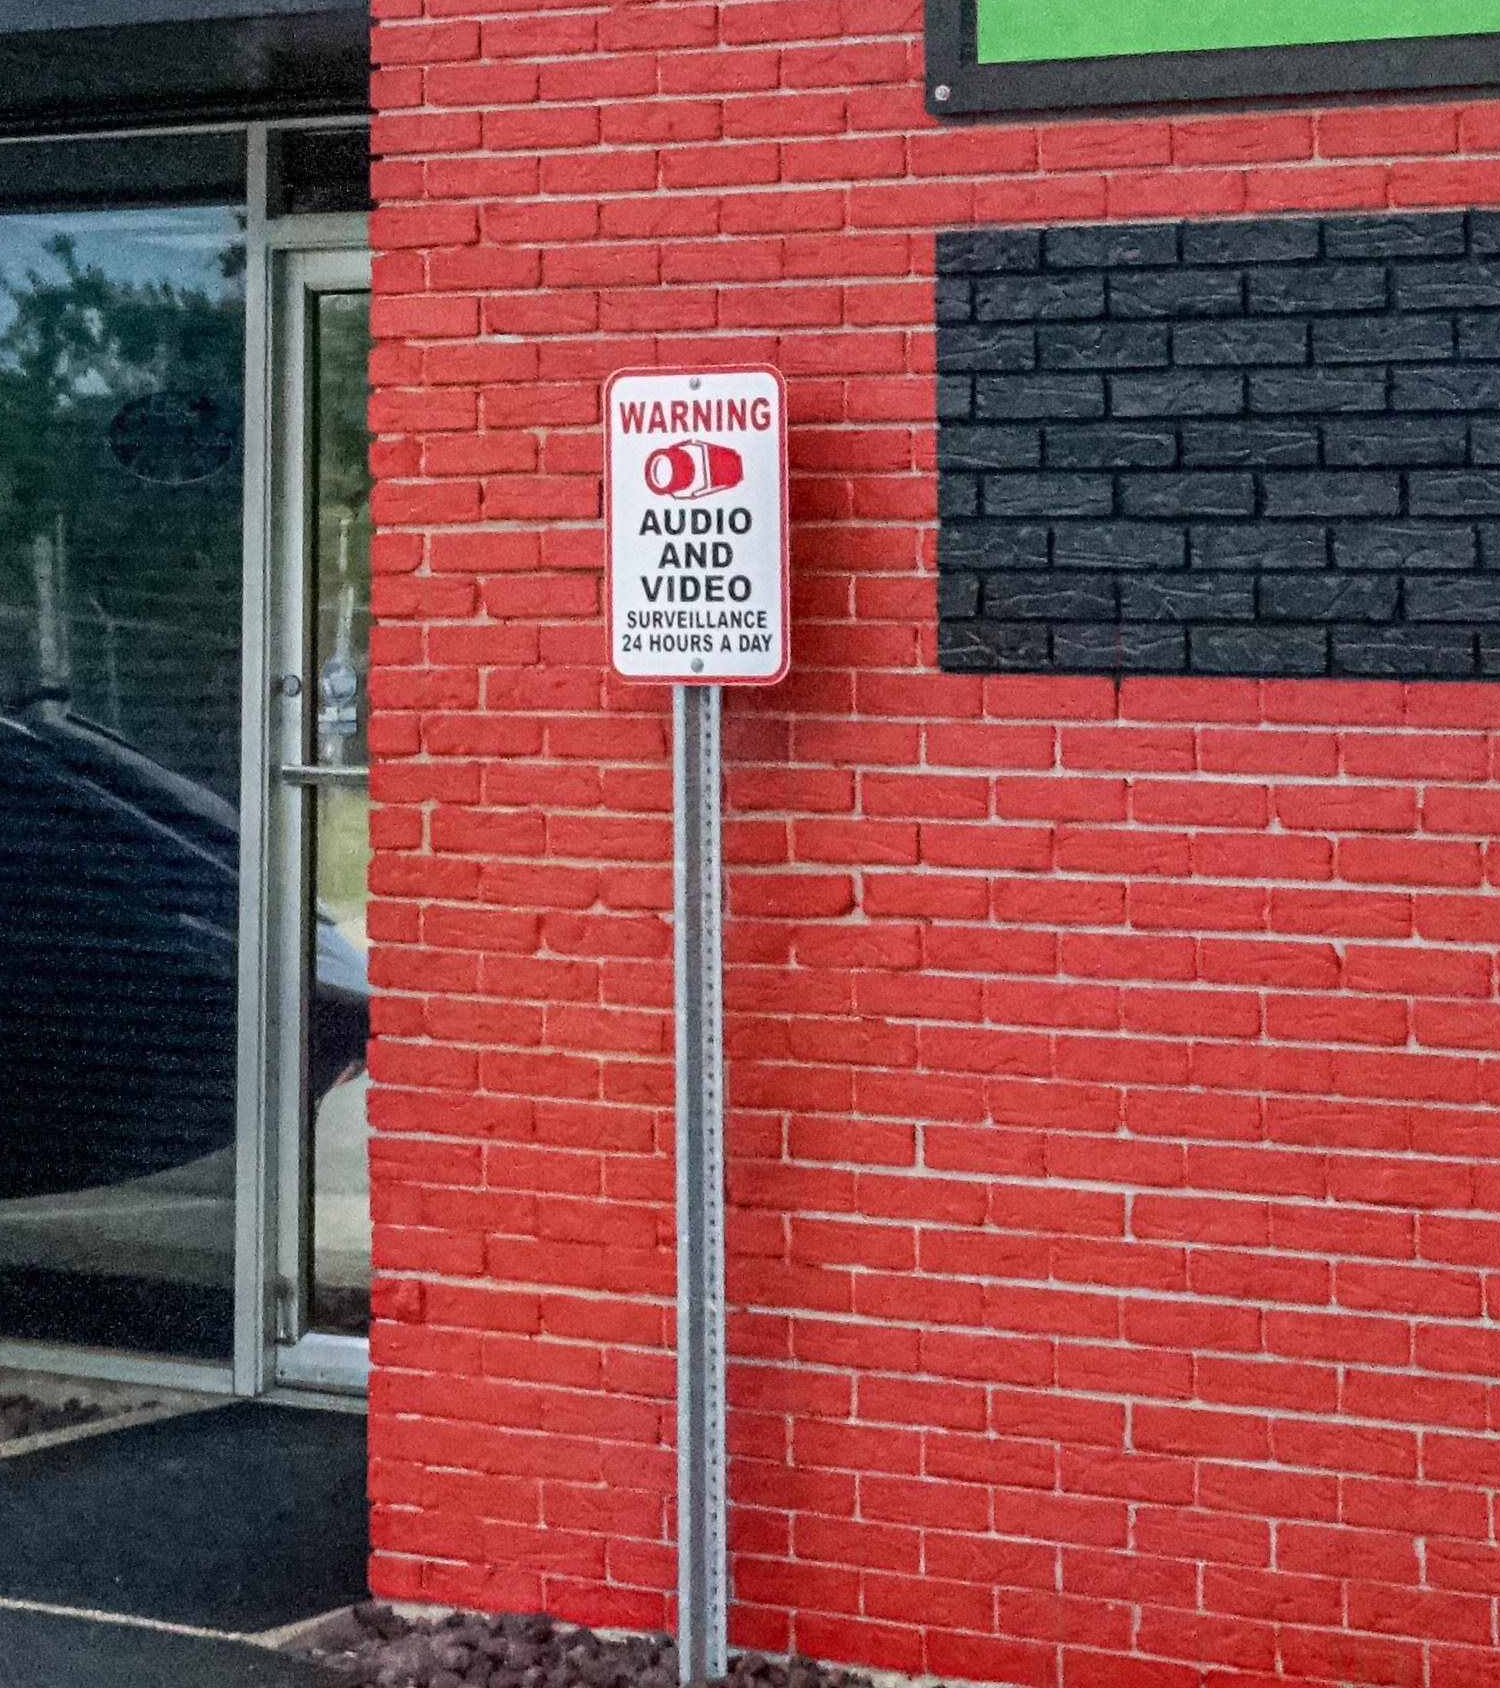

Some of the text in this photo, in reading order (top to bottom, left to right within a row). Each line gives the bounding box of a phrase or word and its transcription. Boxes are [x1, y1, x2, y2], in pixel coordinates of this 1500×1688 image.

[619, 396, 771, 434] WARNING
[639, 508, 752, 536] AUDIO
[658, 541, 733, 569] AND
[641, 575, 752, 603] VIDEO
[626, 610, 768, 629] SURVEILLANCE
[621, 633, 774, 653] 24 HOURS A DAY
